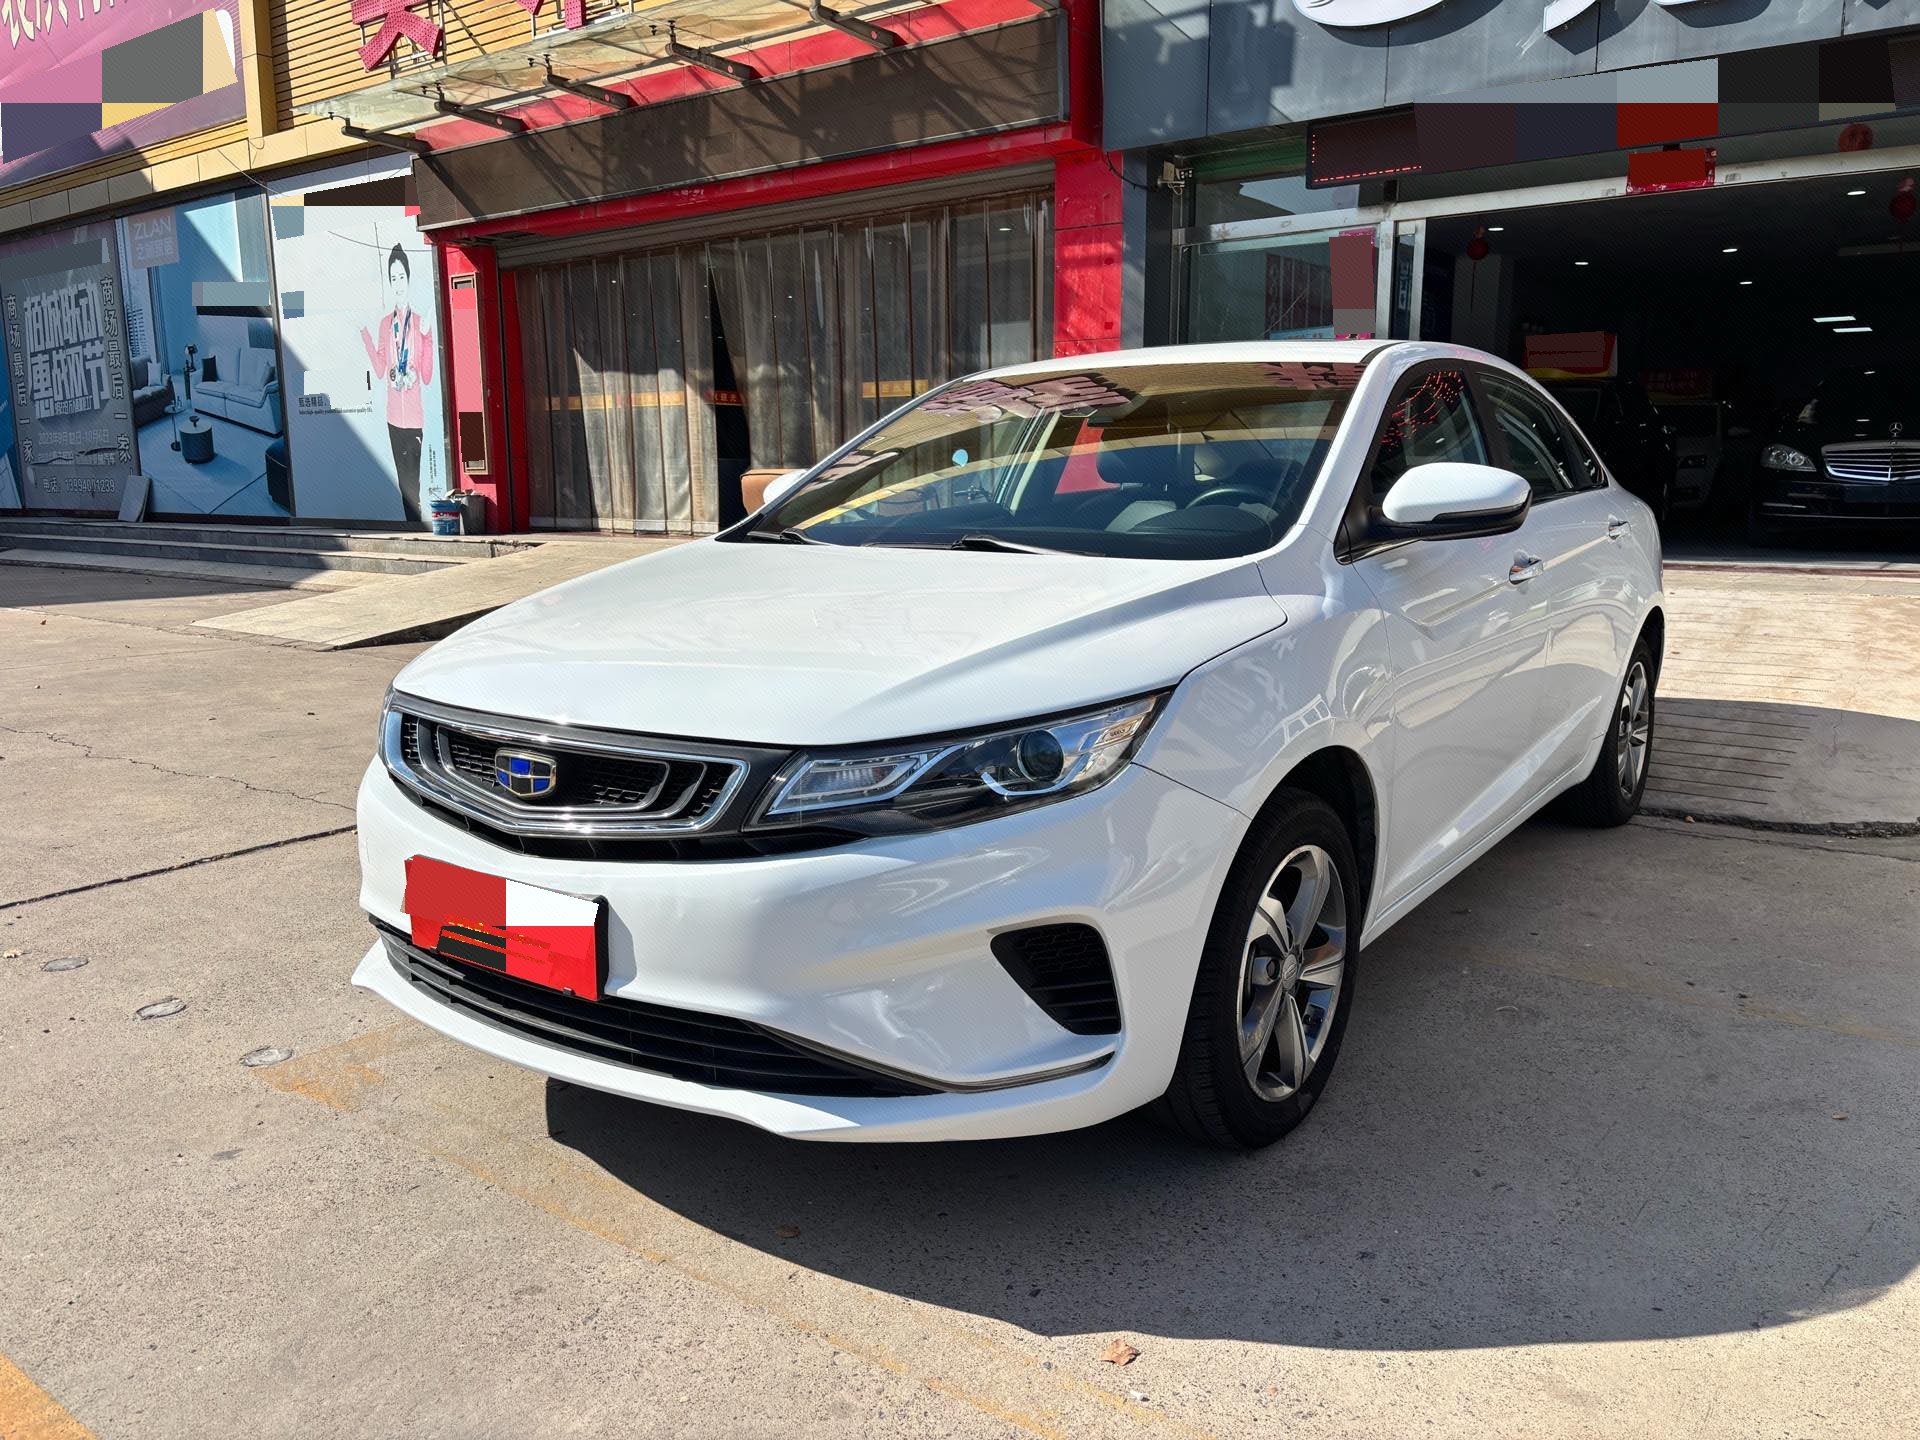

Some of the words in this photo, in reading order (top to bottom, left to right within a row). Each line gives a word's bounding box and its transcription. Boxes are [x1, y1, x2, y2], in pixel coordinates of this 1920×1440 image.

[4, 294, 34, 465] 商场最后一家
[100, 276, 132, 463] 商场最后一家
